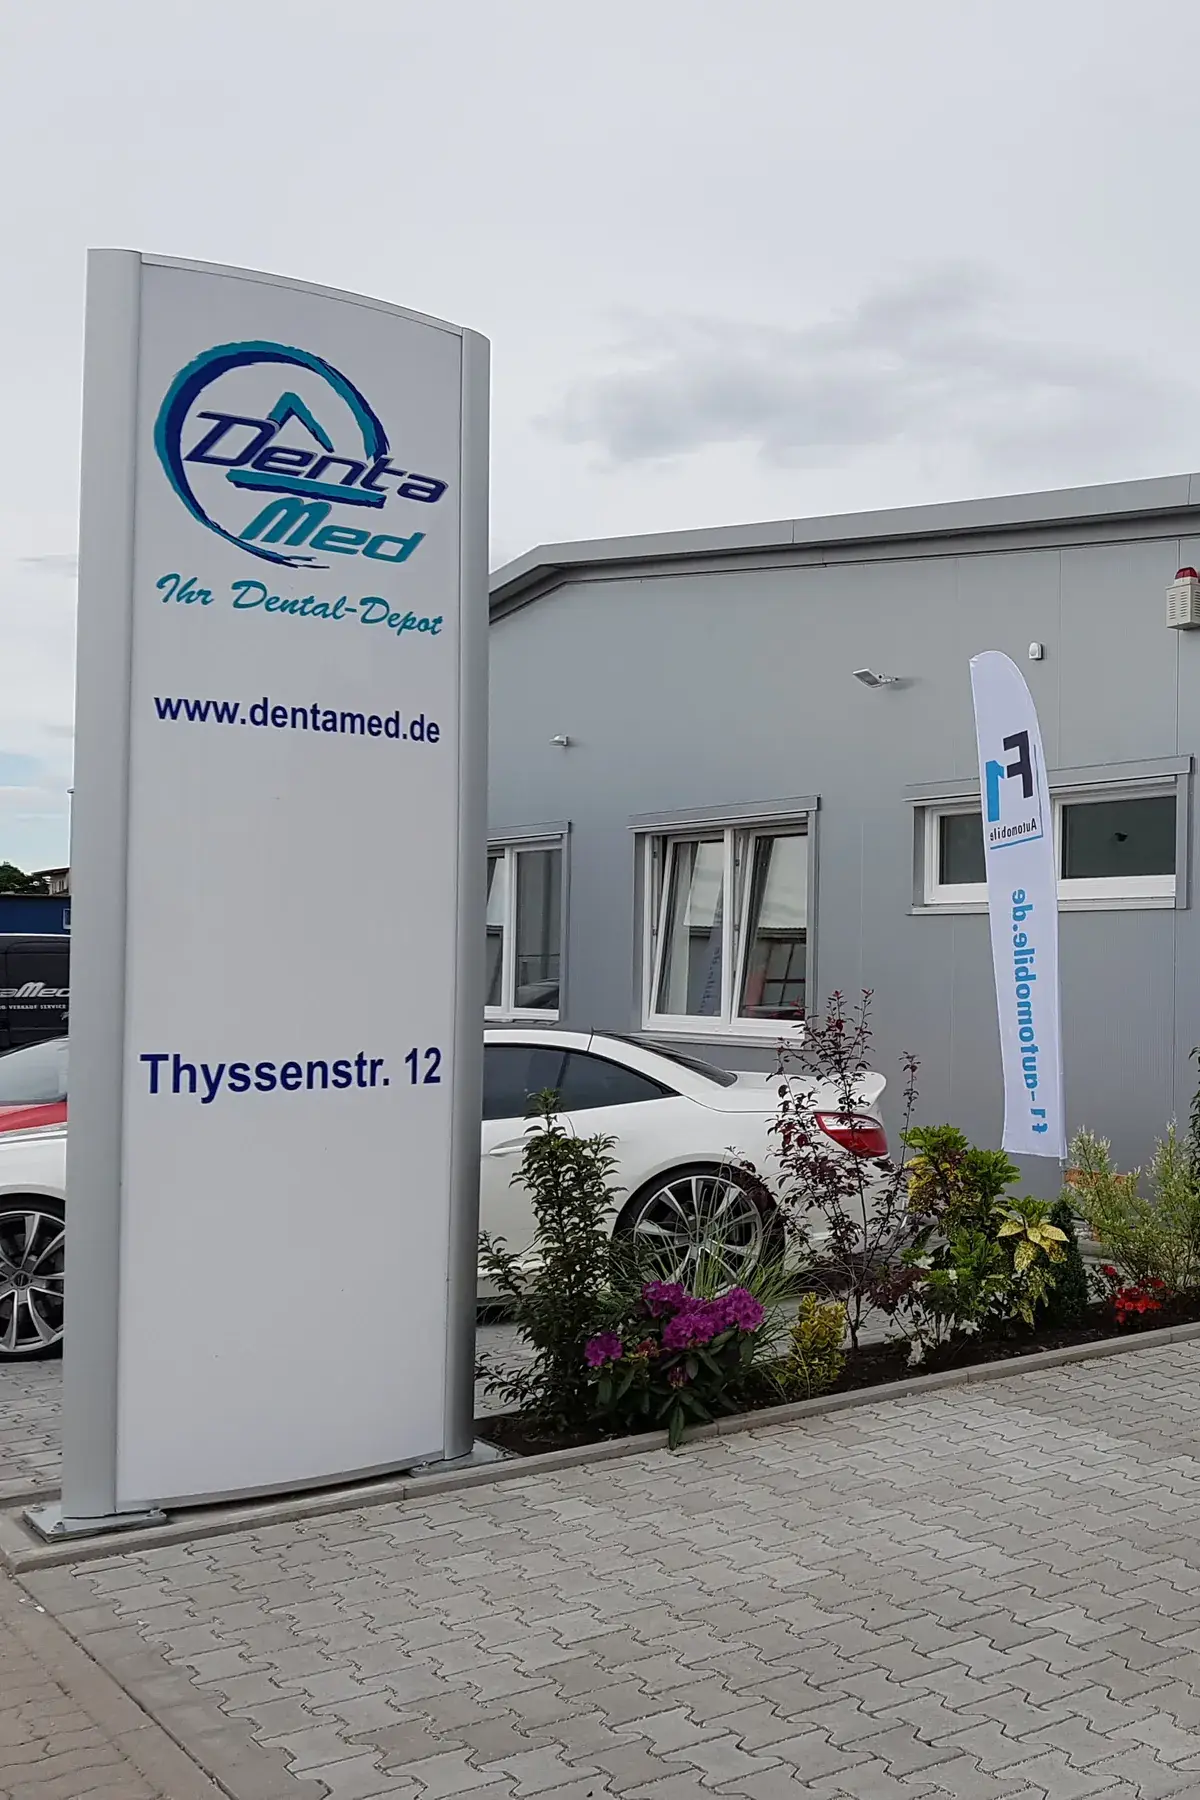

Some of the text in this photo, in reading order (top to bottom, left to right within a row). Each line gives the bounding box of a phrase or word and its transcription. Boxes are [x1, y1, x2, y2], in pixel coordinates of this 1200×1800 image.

[181, 409, 450, 504] Denta
[238, 497, 427, 564] Med
[155, 572, 444, 636] Ihr Dental-Depot
[153, 696, 441, 744] www.dentamed.de
[139, 1046, 443, 1105] Thyssenstr. 12
